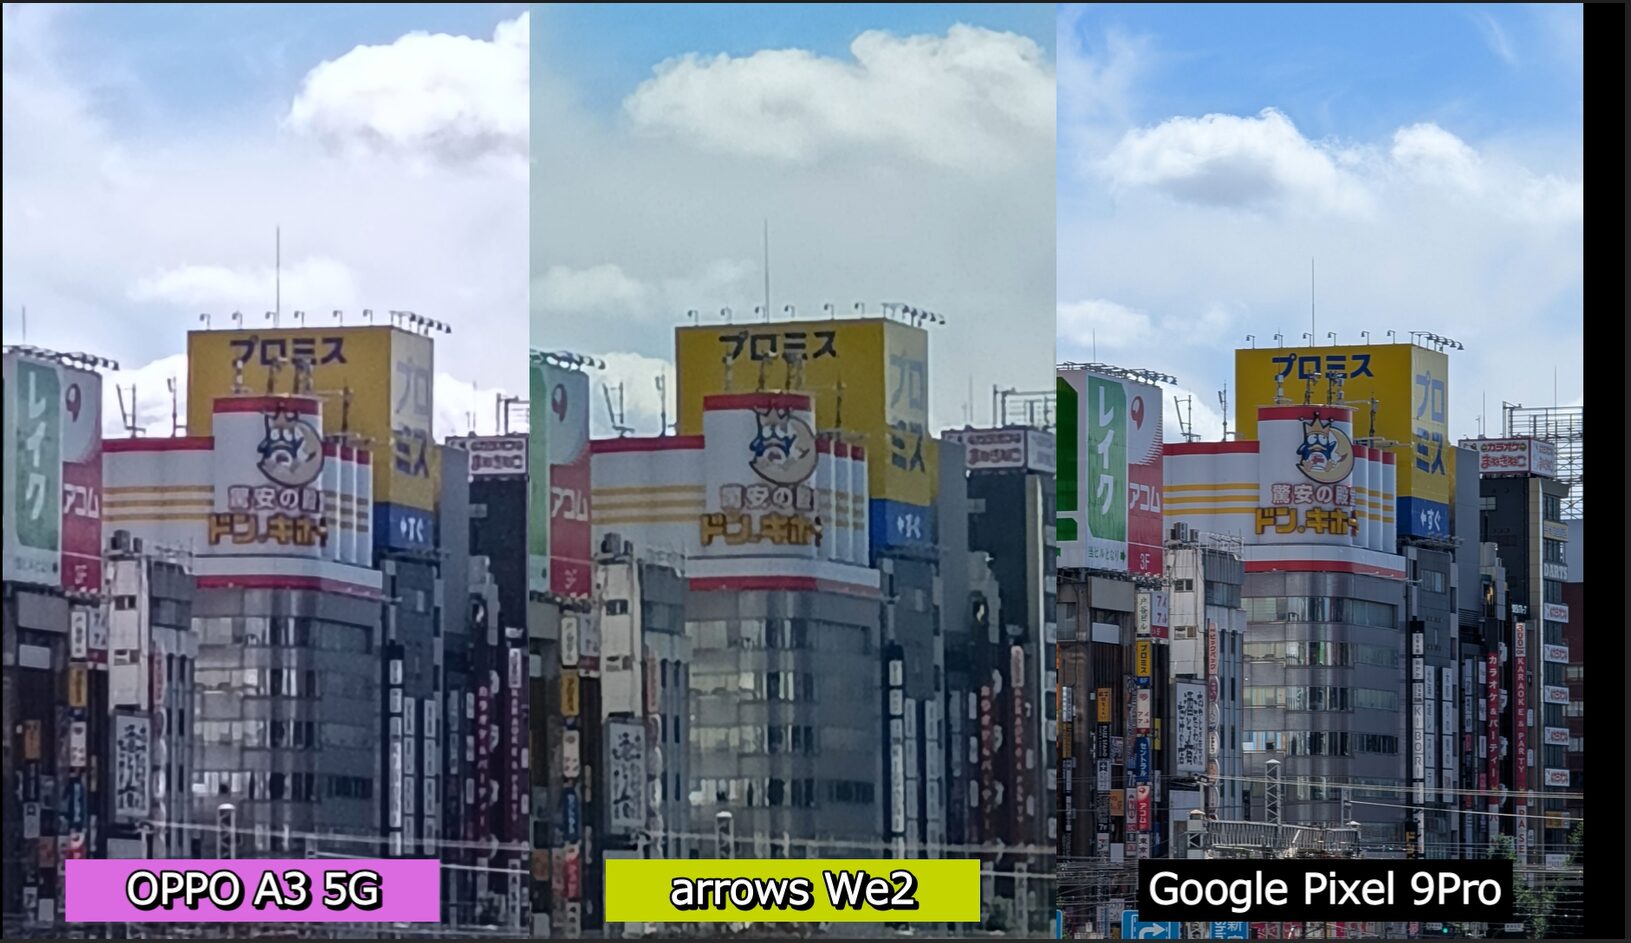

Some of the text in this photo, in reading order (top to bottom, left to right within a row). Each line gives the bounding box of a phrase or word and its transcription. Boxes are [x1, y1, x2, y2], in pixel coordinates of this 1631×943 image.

[229, 337, 346, 366] プロミス
[718, 331, 837, 361] プロミス
[1271, 353, 1374, 382] プロミス
[26, 371, 46, 521] レイク
[1097, 385, 1115, 516] レイク
[1129, 482, 1161, 514] アコム
[1271, 483, 1356, 506] 驚安の殿
[1543, 562, 1568, 580] DARTS
[1140, 645, 1149, 674] プロミス
[1517, 657, 1525, 716] KARAOKE
[1518, 732, 1526, 773] PARTY
